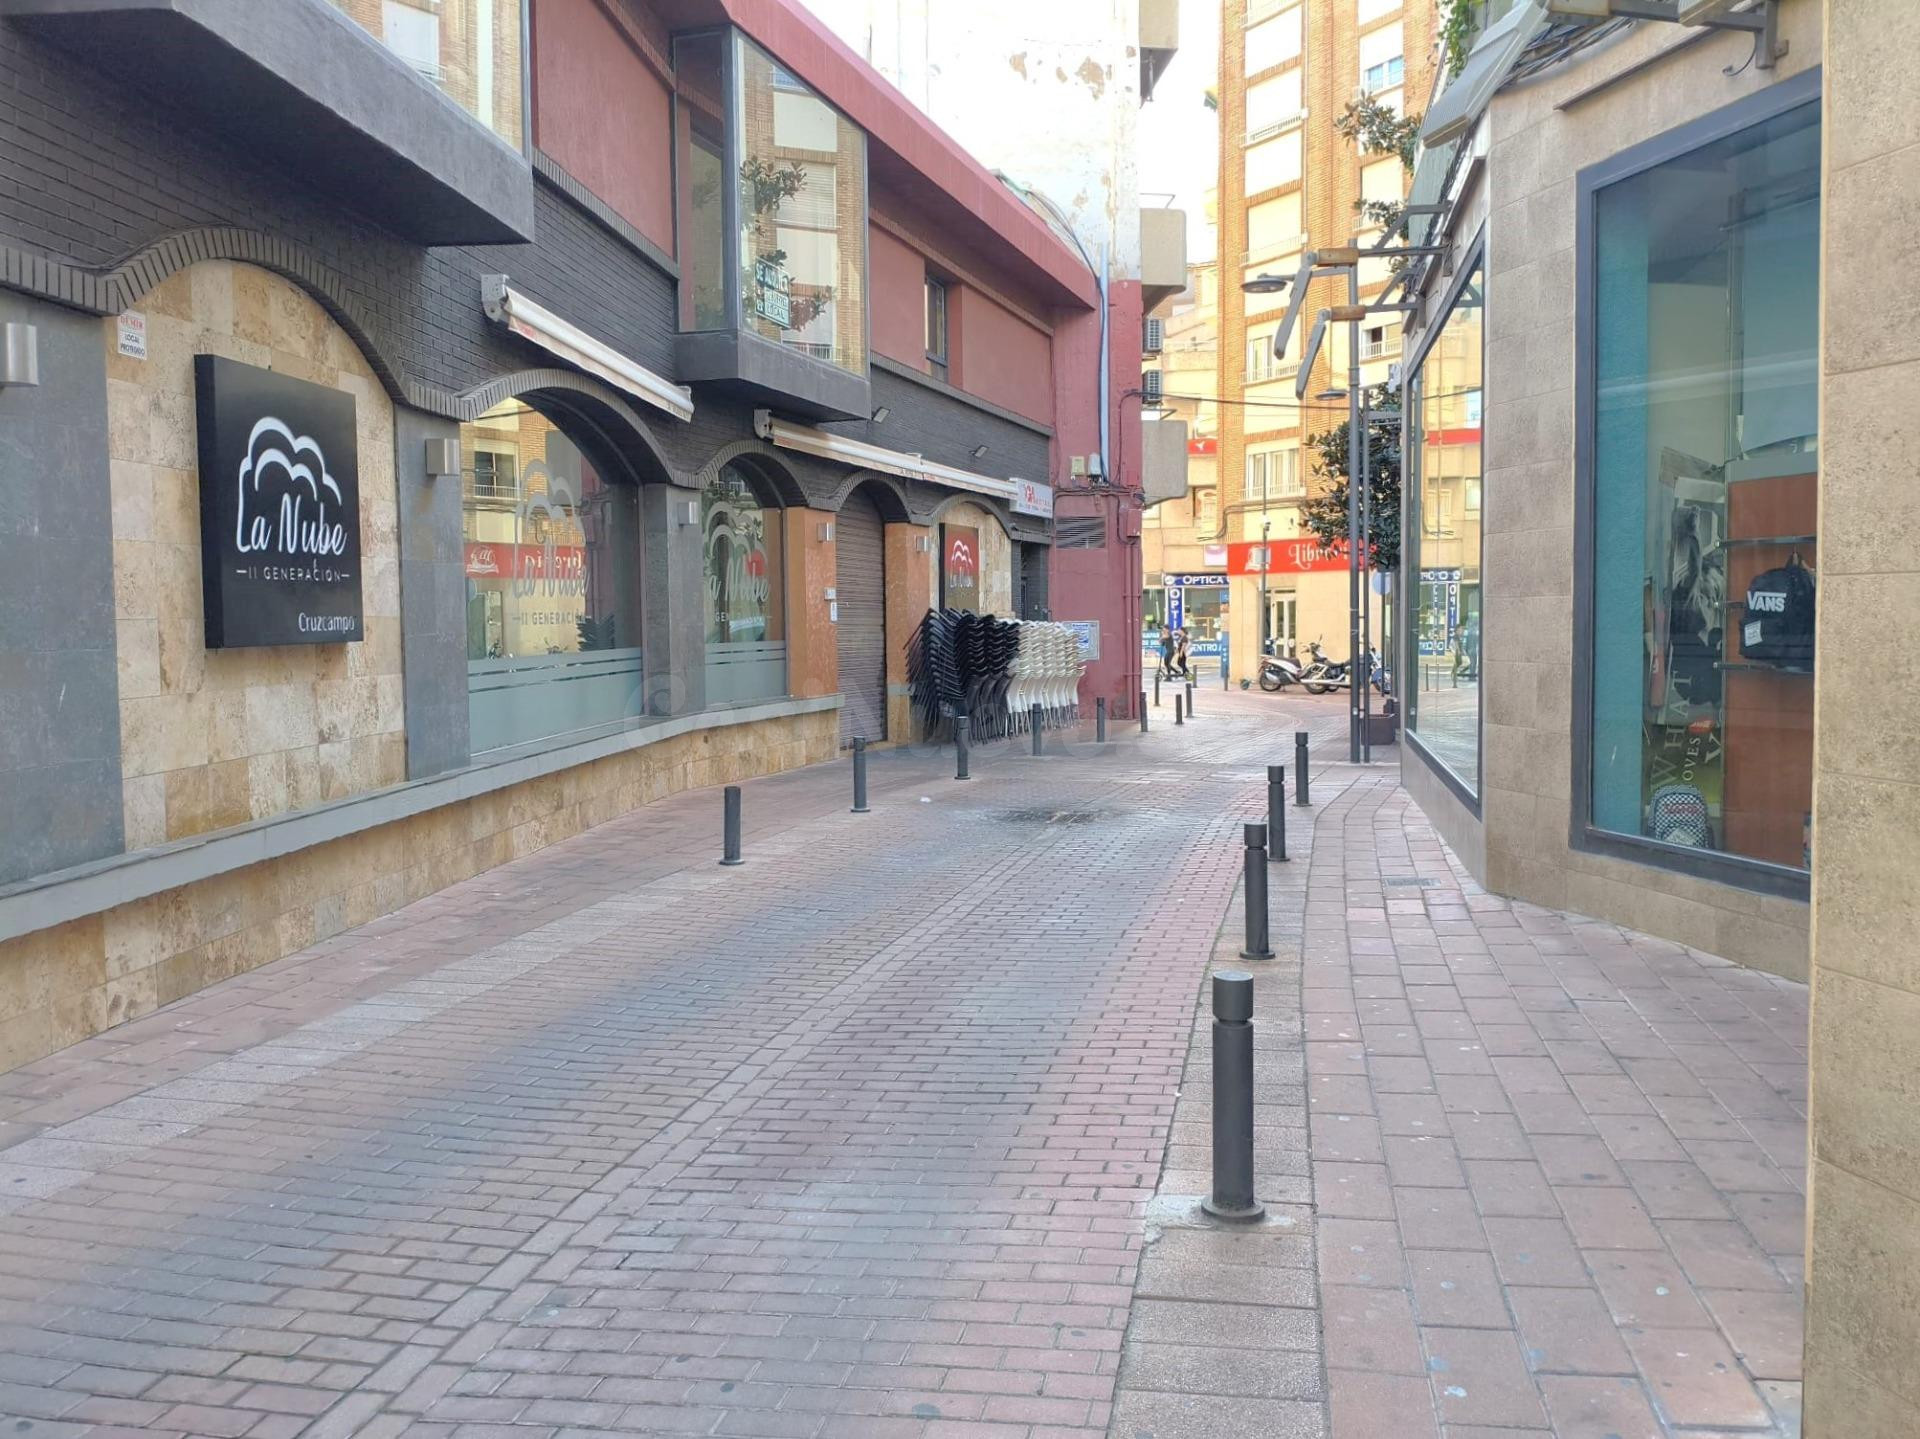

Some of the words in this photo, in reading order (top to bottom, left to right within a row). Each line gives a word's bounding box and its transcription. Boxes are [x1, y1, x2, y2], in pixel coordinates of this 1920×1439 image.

[278, 492, 348, 556] Nube
[1182, 575, 1224, 585] OPTICA
[1747, 591, 1787, 612] VANS
[297, 612, 355, 634] Cruzcampo
[1190, 643, 1217, 652] ENTRO
[1681, 736, 1702, 784] OVES
